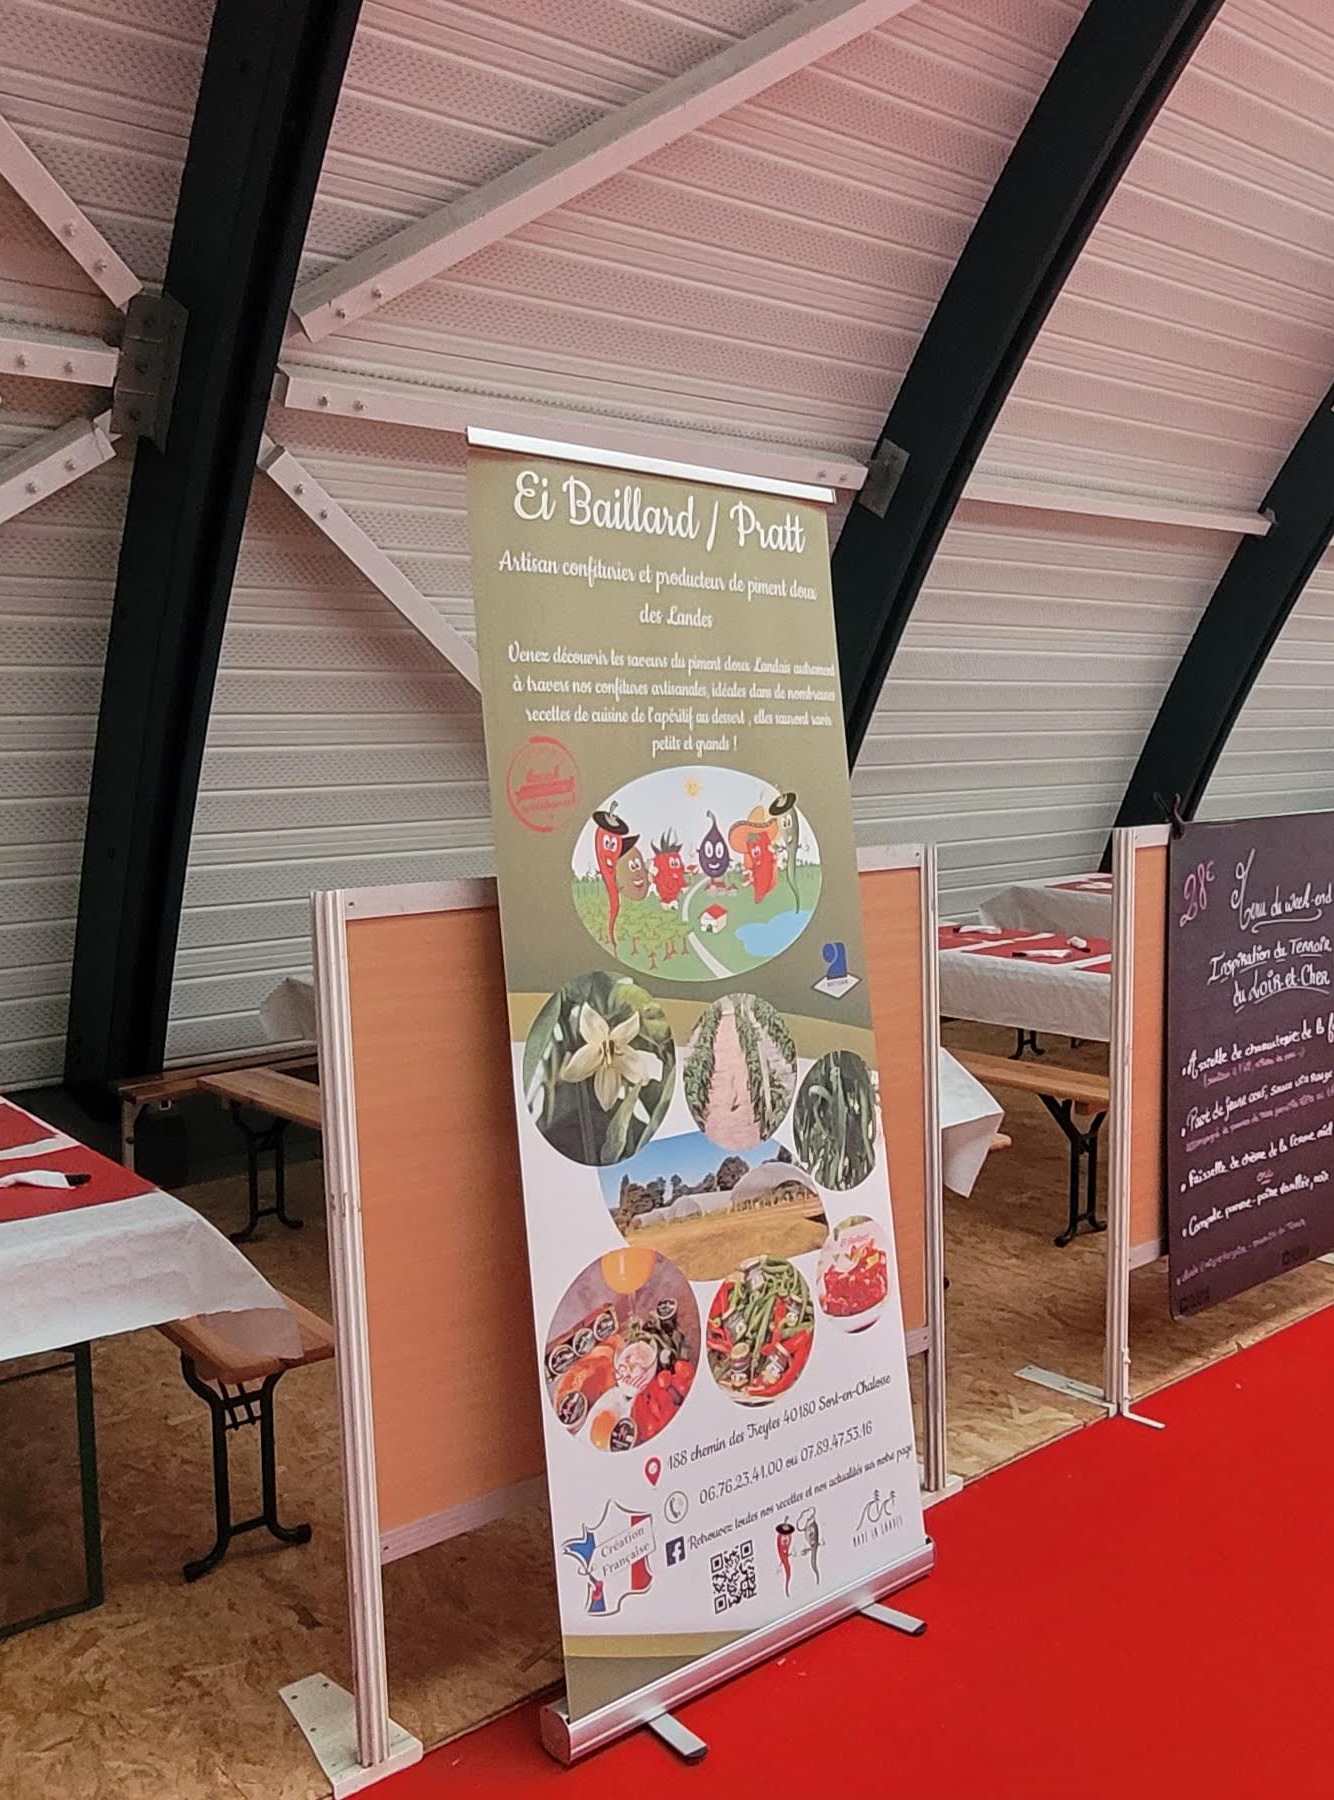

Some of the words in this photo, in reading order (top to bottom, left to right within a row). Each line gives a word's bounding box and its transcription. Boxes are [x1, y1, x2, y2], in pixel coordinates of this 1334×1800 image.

[514, 470, 556, 521] Ei
[562, 475, 700, 540] Baillard
[707, 500, 719, 552] /
[730, 500, 806, 554] Pratt
[499, 550, 559, 575] Artisan
[562, 556, 636, 588] confiturier
[639, 565, 652, 584] et
[655, 567, 725, 594] producteur
[729, 572, 745, 593] de
[748, 576, 787, 602] piment
[790, 580, 817, 601] doux
[640, 603, 662, 624] des
[667, 604, 714, 629] Landes
[508, 640, 551, 664] Venez
[553, 645, 610, 665] découvrir
[611, 648, 625, 666] les
[627, 654, 668, 669] saveurs
[671, 652, 685, 668] du
[688, 655, 721, 676] piment
[724, 656, 751, 672] doux
[754, 657, 791, 674] Landais
[794, 661, 836, 677] autrement
[513, 675, 523, 692] à
[527, 676, 569, 693] travers
[572, 681, 592, 693] nos
[595, 676, 648, 702] confitures
[712, 681, 747, 698] idéales
[749, 682, 772, 699] dans
[774, 683, 786, 699] de
[526, 706, 570, 722] recettes
[574, 705, 590, 722] de
[592, 707, 629, 723] cuisine
[631, 706, 646, 722] de
[696, 713, 709, 725] au
[712, 706, 745, 725] dessert
[754, 708, 773, 725] elles
[775, 710, 809, 726] sauront
[652, 735, 681, 758] petits
[683, 735, 693, 751] et
[696, 734, 730, 758] grands
[1270, 885, 1283, 917] du
[1233, 980, 1247, 1007] du
[1231, 1043, 1243, 1061] de
[1301, 1019, 1313, 1040] de
[668, 1450, 688, 1470] 188
[690, 1437, 726, 1461] chemin
[729, 1429, 745, 1446] des
[782, 1400, 816, 1424] 40180
[785, 1455, 799, 1468] ou
[688, 1524, 734, 1551] Retrouvez
[735, 1511, 759, 1529] toutes
[760, 1506, 774, 1517] nos
[775, 1491, 803, 1511] recettes
[805, 1484, 813, 1498] et
[814, 1480, 827, 1495] nos
[602, 1543, 650, 1577] Française
